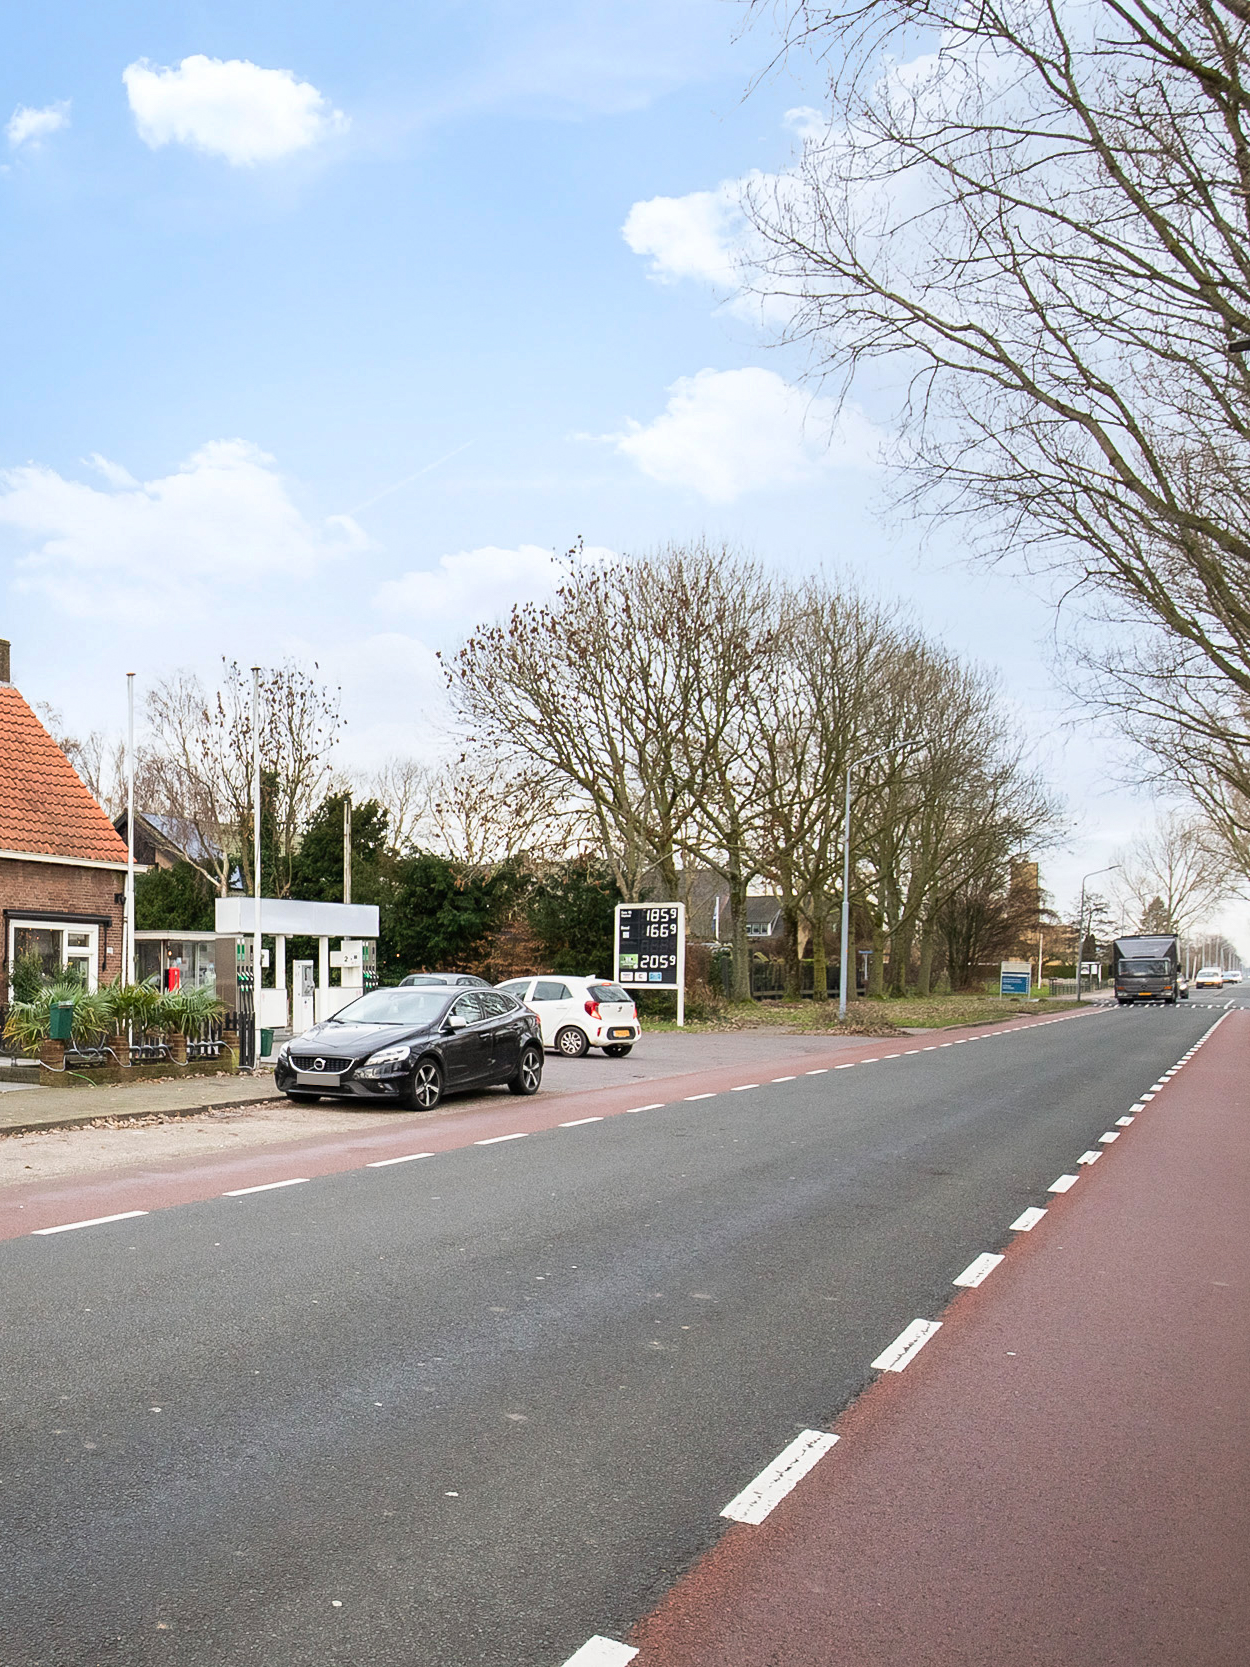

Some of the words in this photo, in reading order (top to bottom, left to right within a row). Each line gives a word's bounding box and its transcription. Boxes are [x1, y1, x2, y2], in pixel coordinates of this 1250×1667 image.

[646, 908, 677, 922] 1859
[646, 924, 677, 937] 1669
[640, 955, 676, 968] 2059
